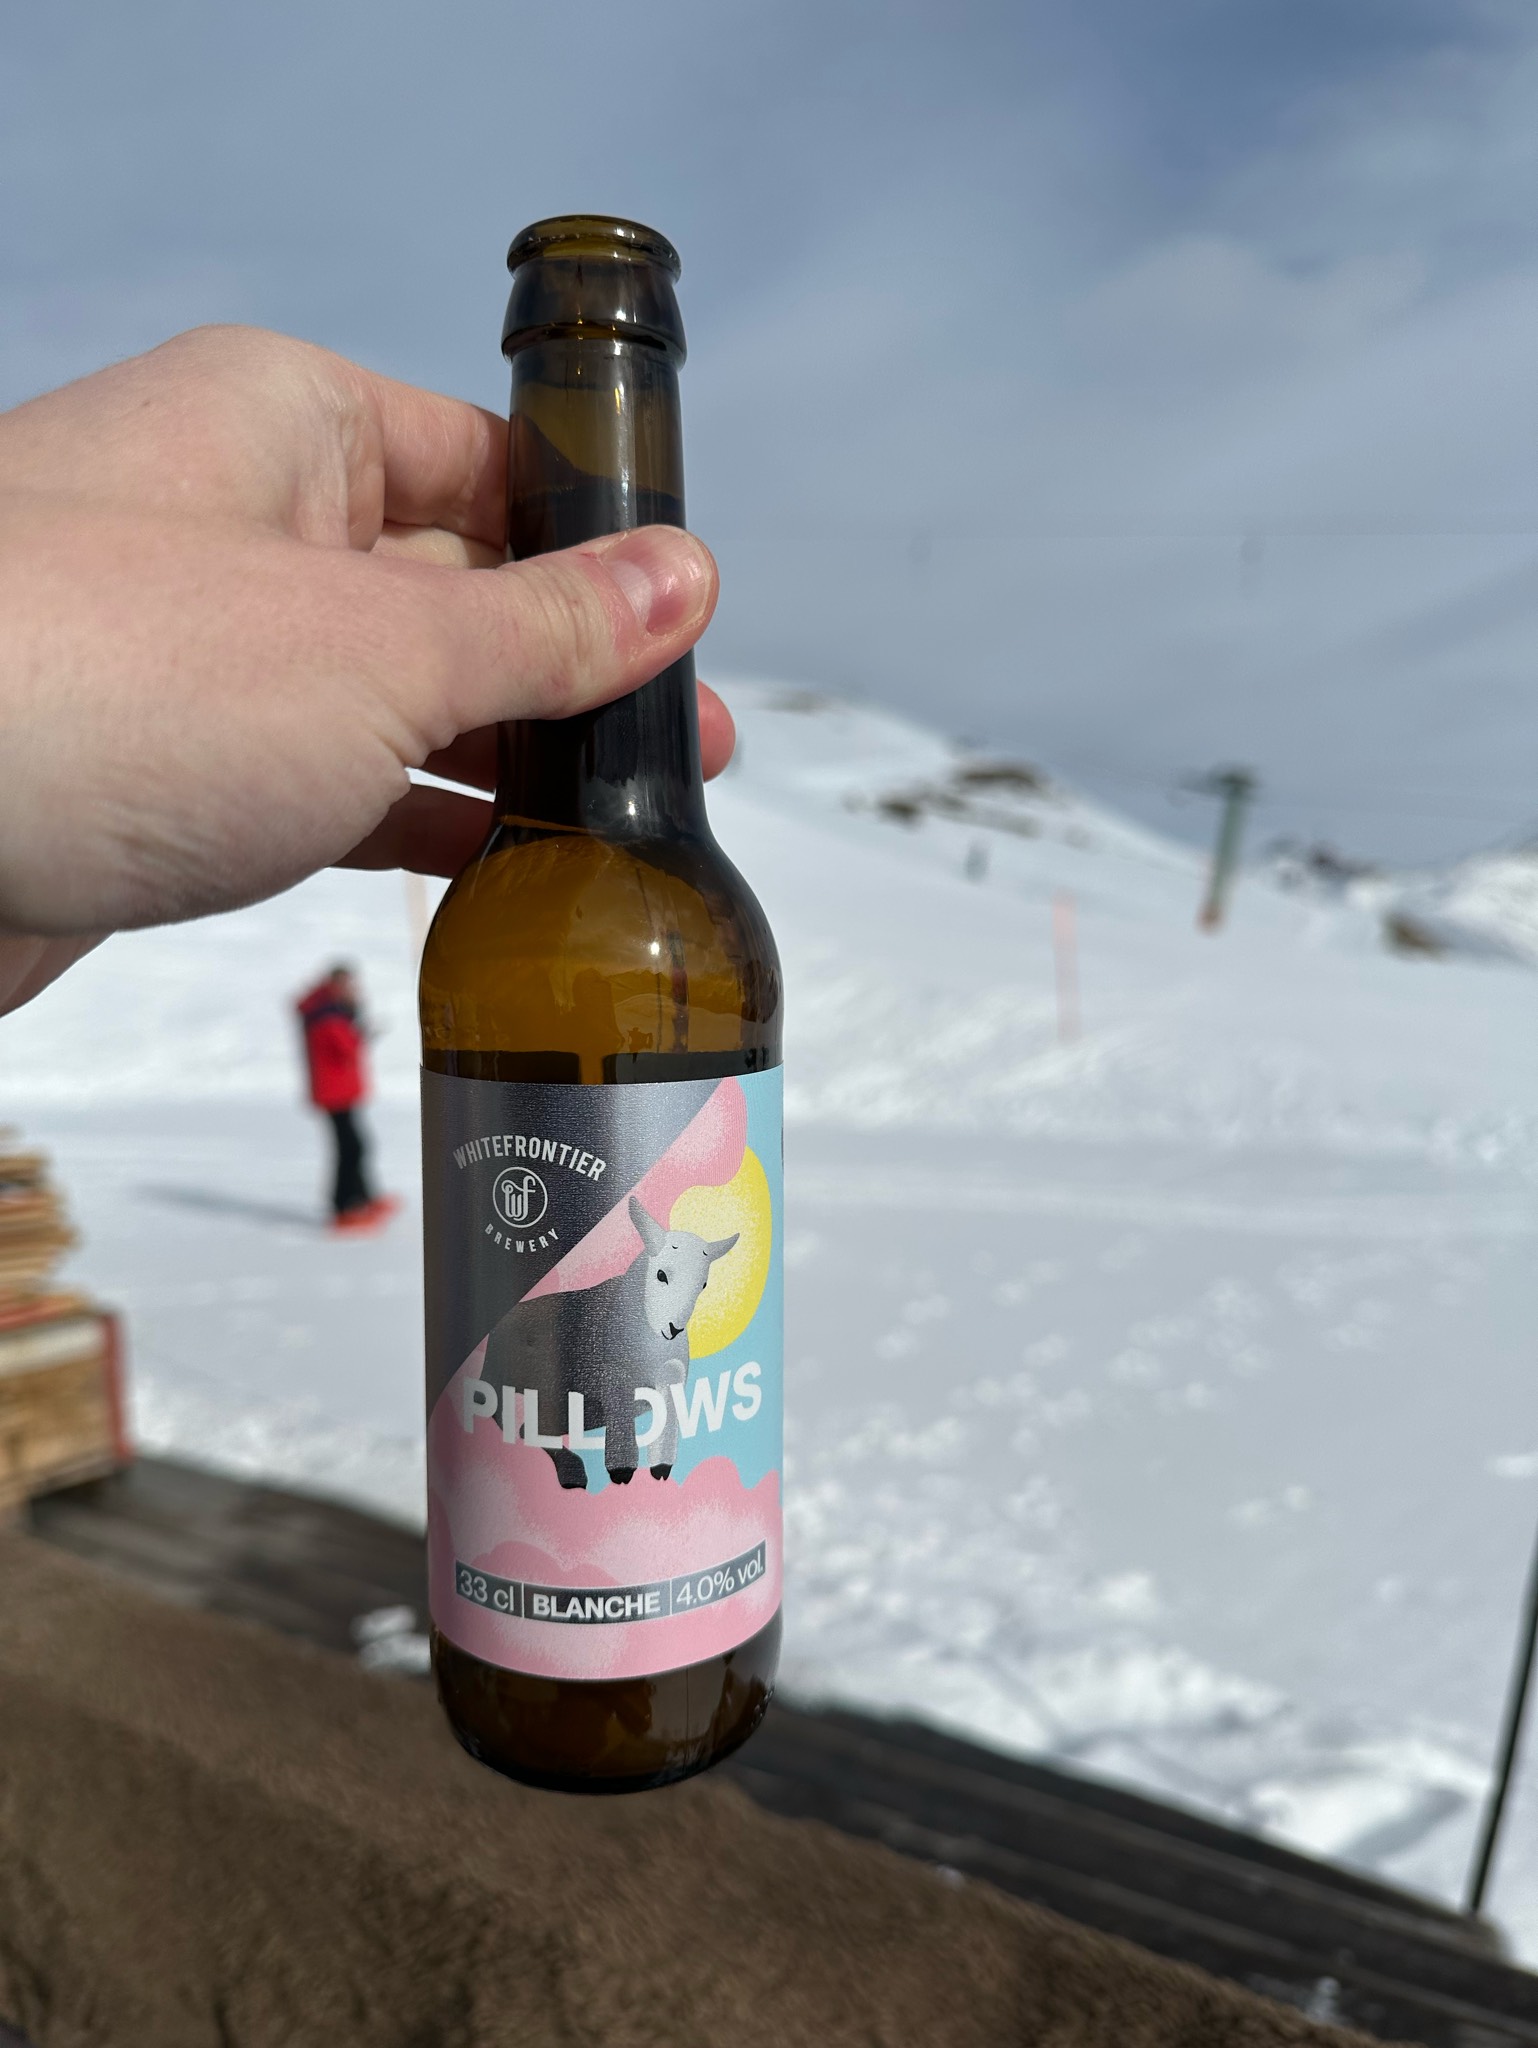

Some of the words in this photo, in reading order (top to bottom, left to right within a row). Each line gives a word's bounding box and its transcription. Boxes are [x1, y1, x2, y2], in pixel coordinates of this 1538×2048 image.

[453, 1134, 607, 1182] WHITEFRONTIER
[485, 1223, 560, 1254] BREWERY
[459, 1569, 488, 1601] 33
[493, 1585, 515, 1612] cl
[532, 1591, 661, 1619] BLANCHE
[676, 1570, 735, 1605] 4.0%
[738, 1552, 764, 1583] vol.
